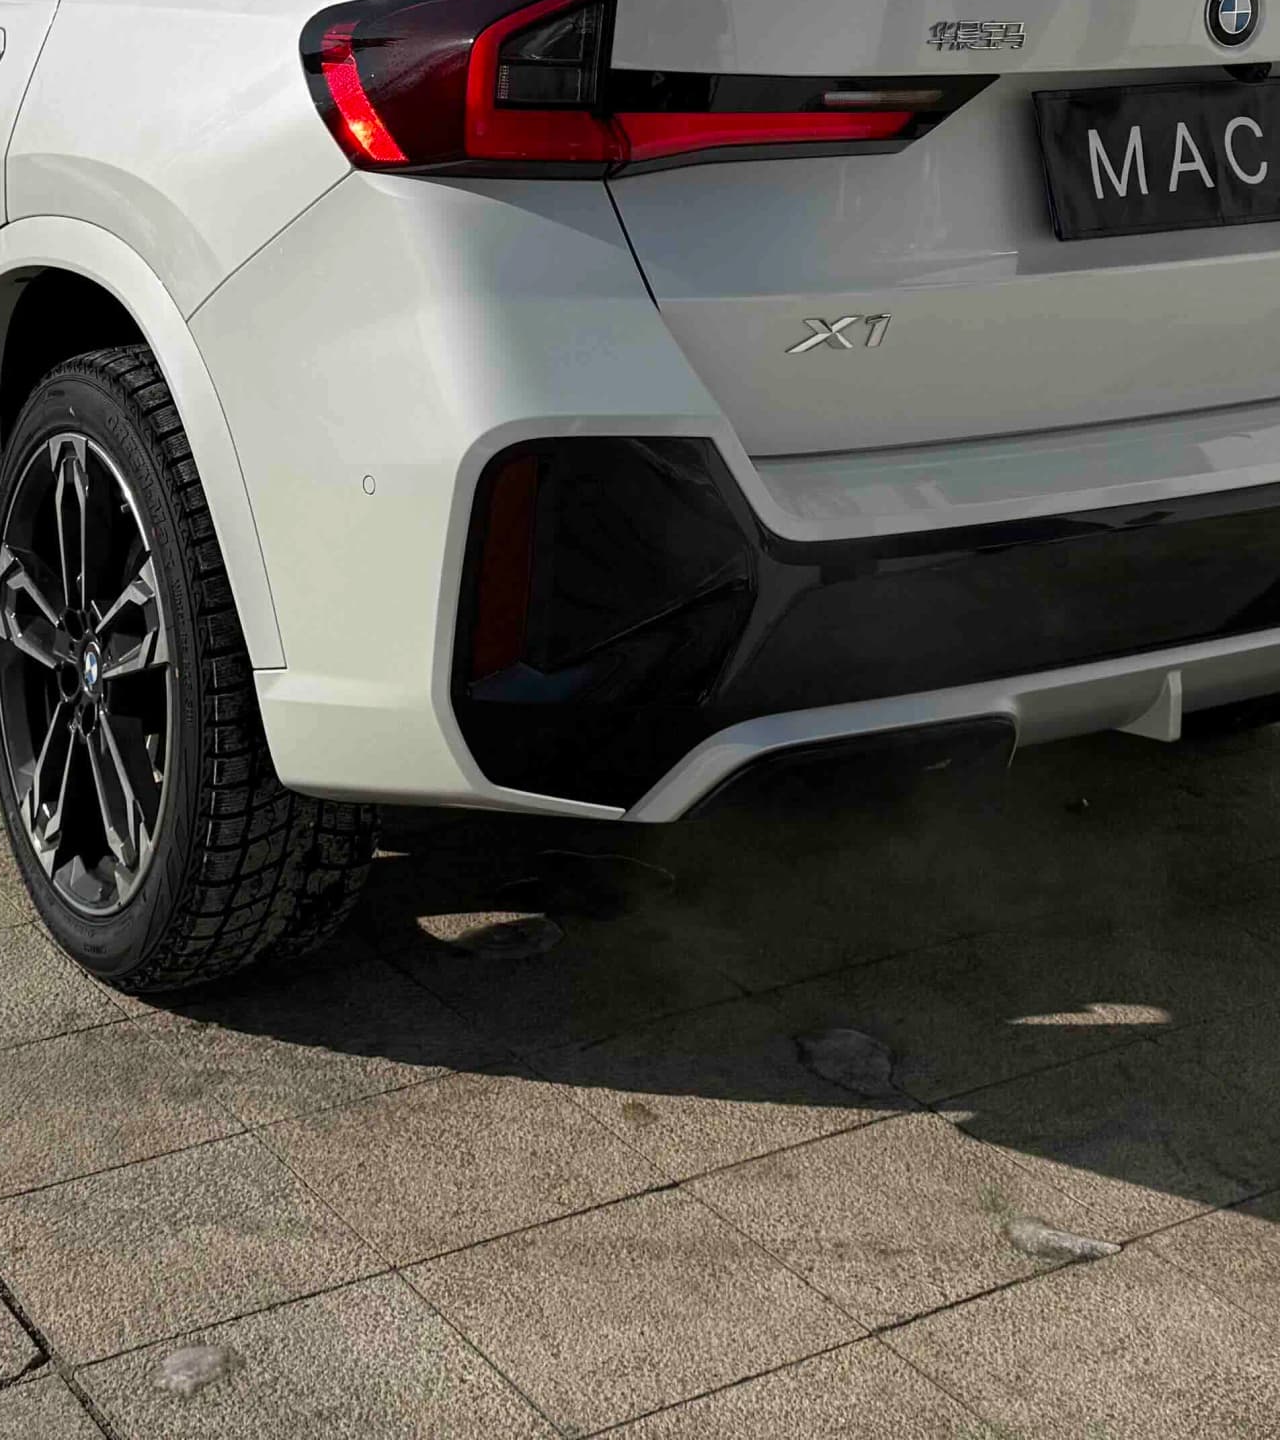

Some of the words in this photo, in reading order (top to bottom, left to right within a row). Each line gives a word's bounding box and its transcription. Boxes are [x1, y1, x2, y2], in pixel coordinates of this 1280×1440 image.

[926, 20, 1027, 51] 华晨宝马
[784, 313, 892, 353] X1
